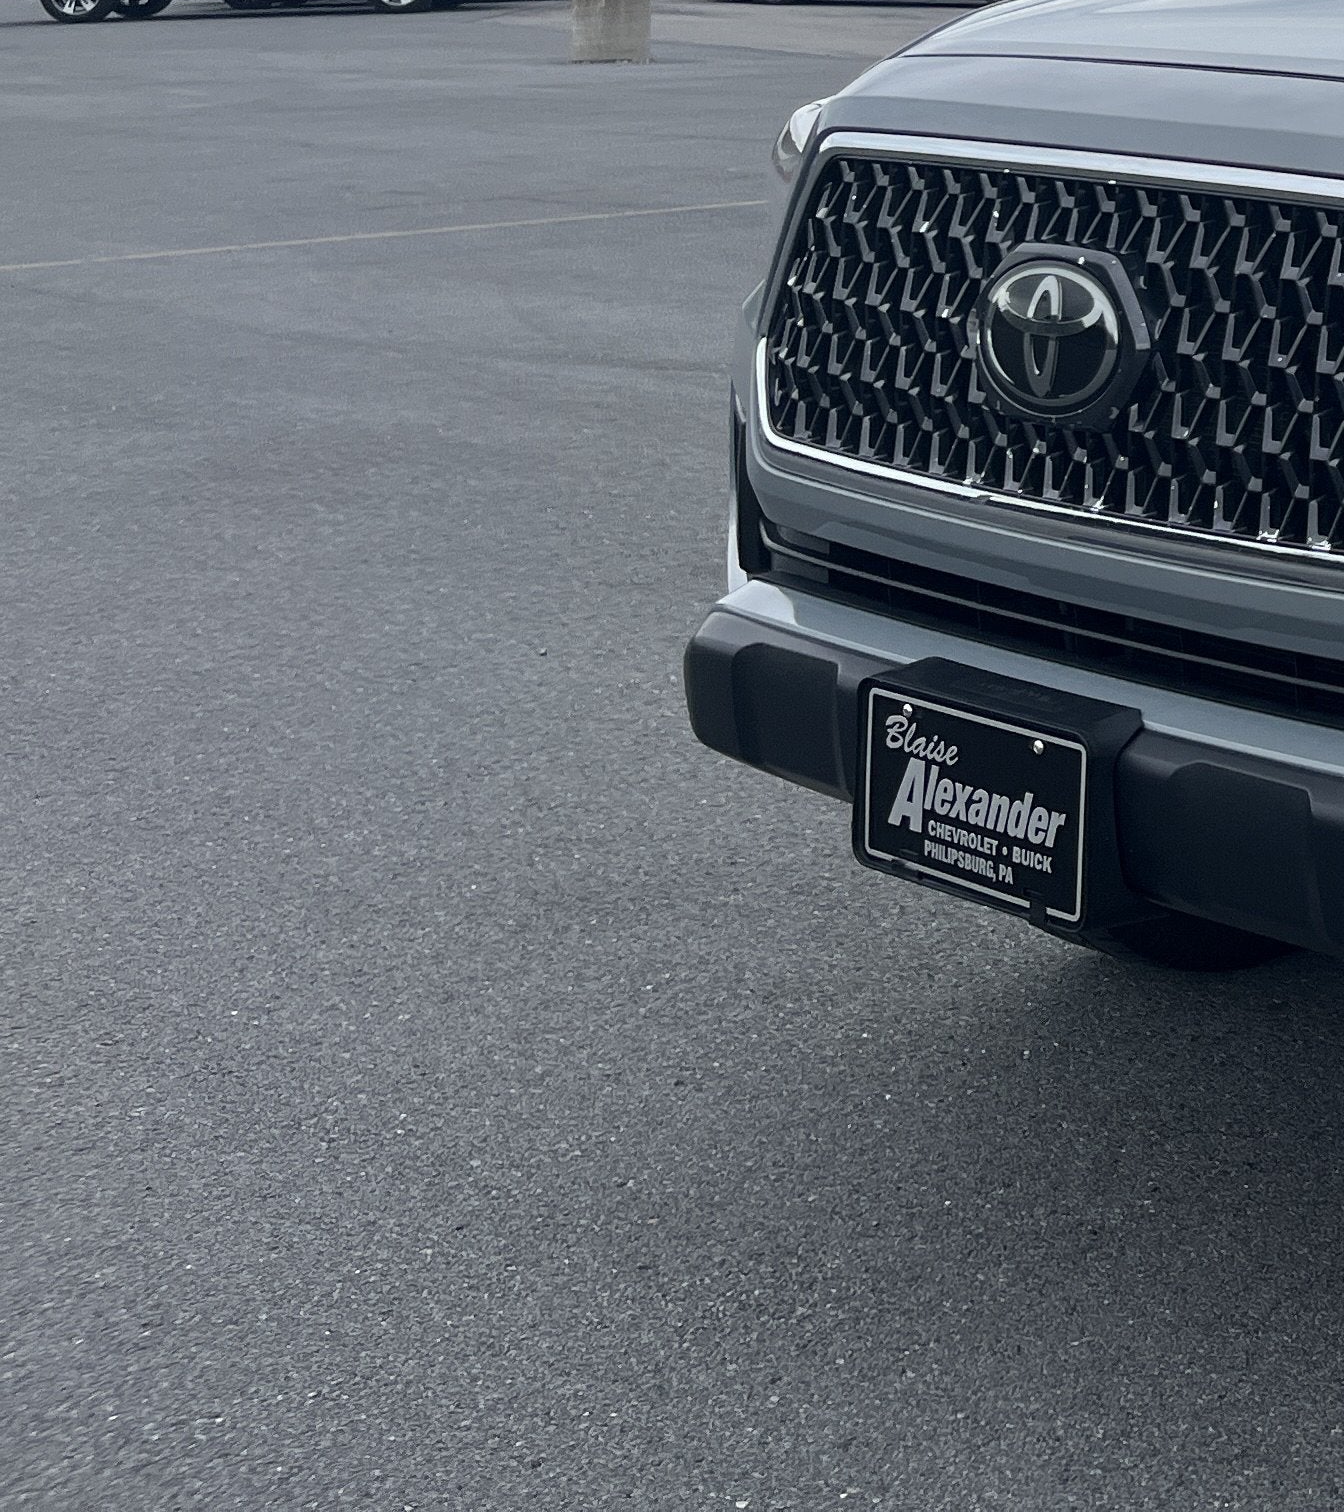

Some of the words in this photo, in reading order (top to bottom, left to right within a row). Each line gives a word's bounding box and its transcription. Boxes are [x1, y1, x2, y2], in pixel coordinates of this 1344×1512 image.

[885, 714, 959, 766] Blaise
[887, 756, 1067, 849] Alexander
[923, 839, 997, 883] PHILIPSBURG,
[998, 863, 1014, 885] PA
[927, 819, 999, 856] CHEVROLET
[1012, 845, 1053, 874] BUICK
